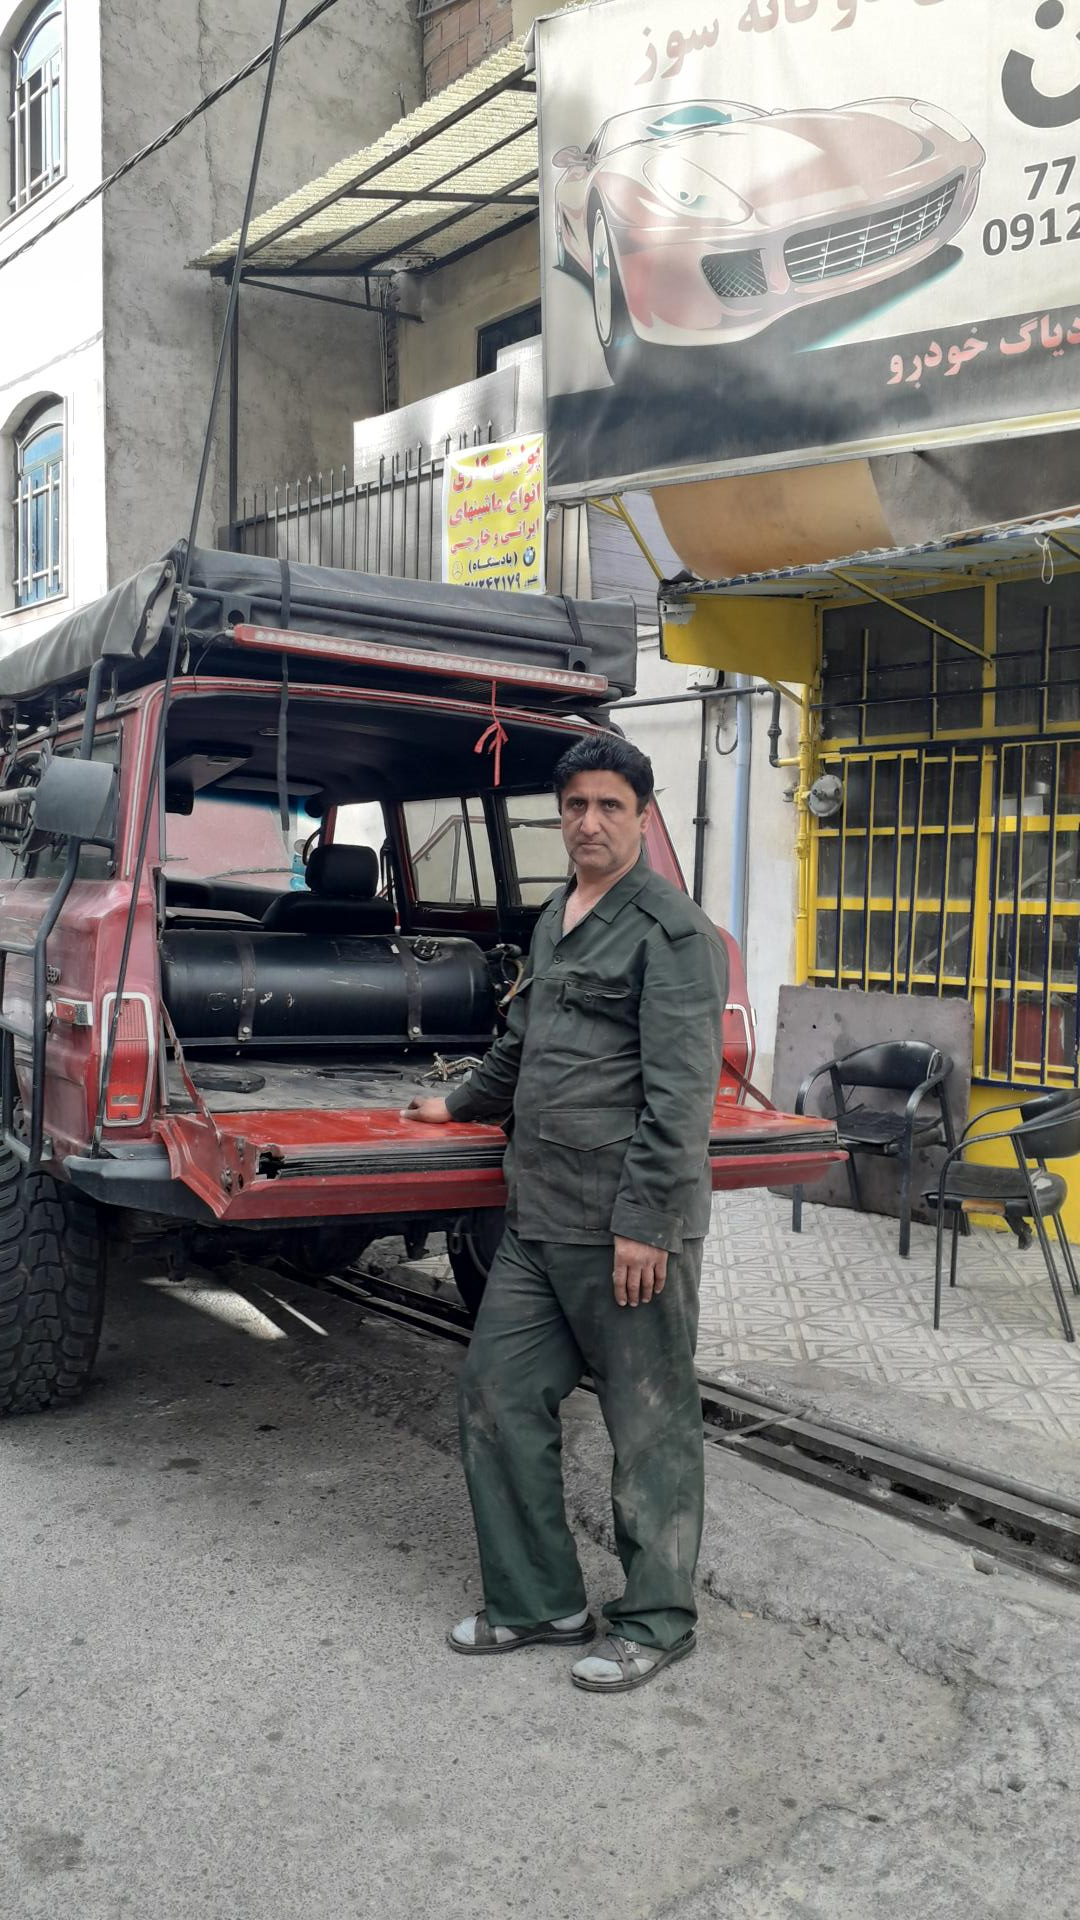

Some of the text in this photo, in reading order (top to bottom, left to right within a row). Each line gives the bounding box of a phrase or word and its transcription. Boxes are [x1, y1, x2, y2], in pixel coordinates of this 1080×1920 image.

[634, 18, 720, 86] سوز
[1023, 155, 1077, 201] 77
[982, 202, 1080, 256] 0912
[886, 326, 989, 389] خودرو
[449, 480, 541, 527] انواع ماشینهای
[450, 516, 540, 555] ایرانی و خارجی
